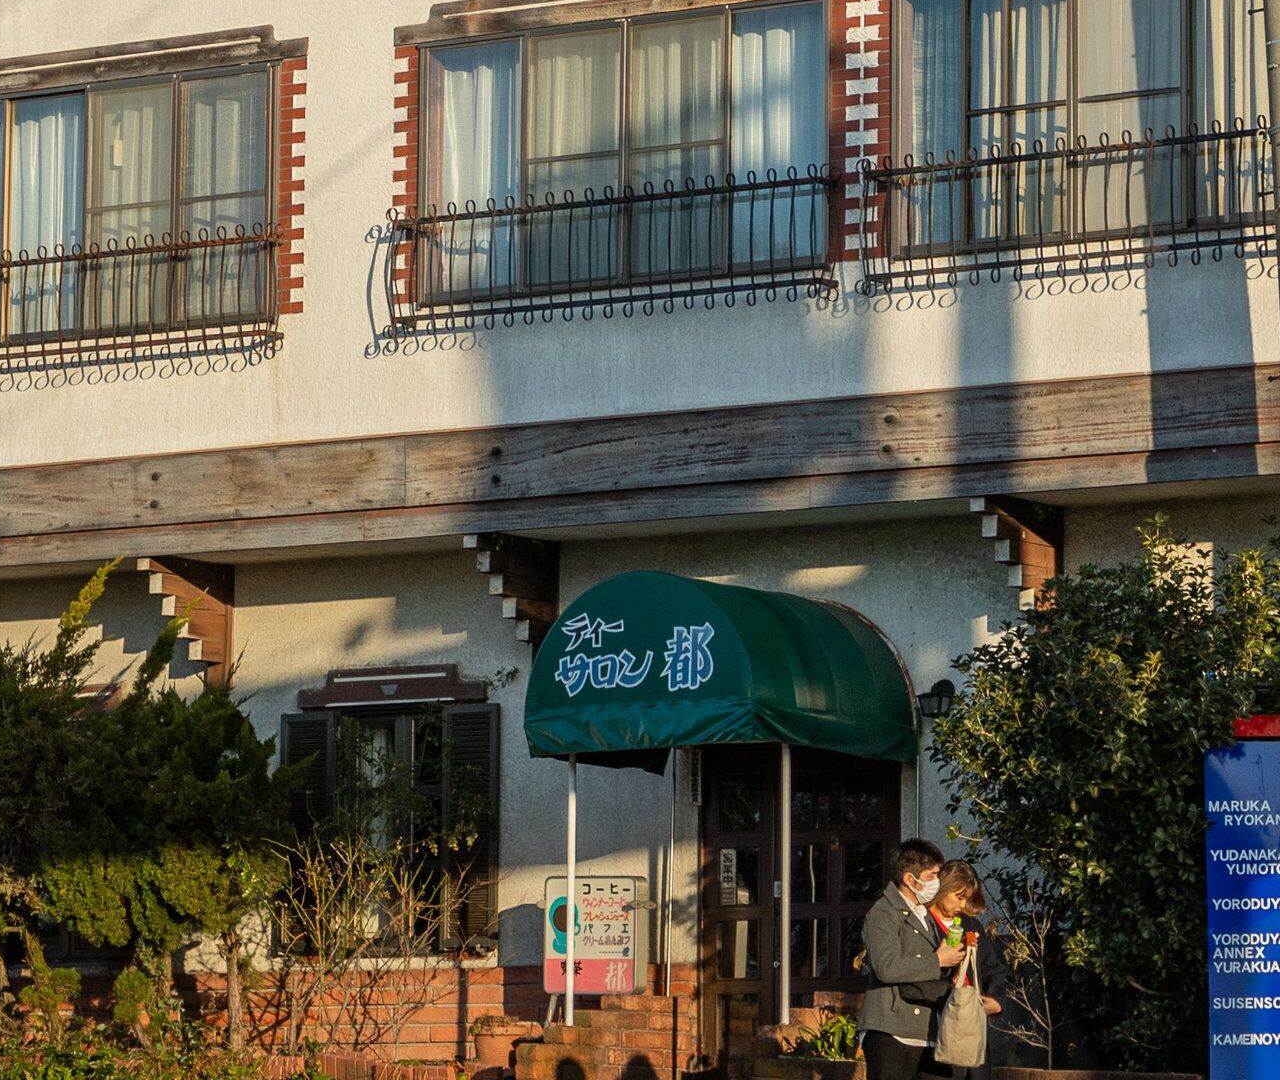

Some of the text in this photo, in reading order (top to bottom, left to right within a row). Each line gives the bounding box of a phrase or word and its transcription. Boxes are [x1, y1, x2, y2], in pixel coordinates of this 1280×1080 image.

[561, 612, 624, 652] ティー
[554, 622, 715, 697] サロン 都
[1208, 800, 1270, 812] MARUKA
[582, 883, 631, 895] コーヒー
[1213, 947, 1265, 959] ANNEX
[604, 961, 628, 990] 都
